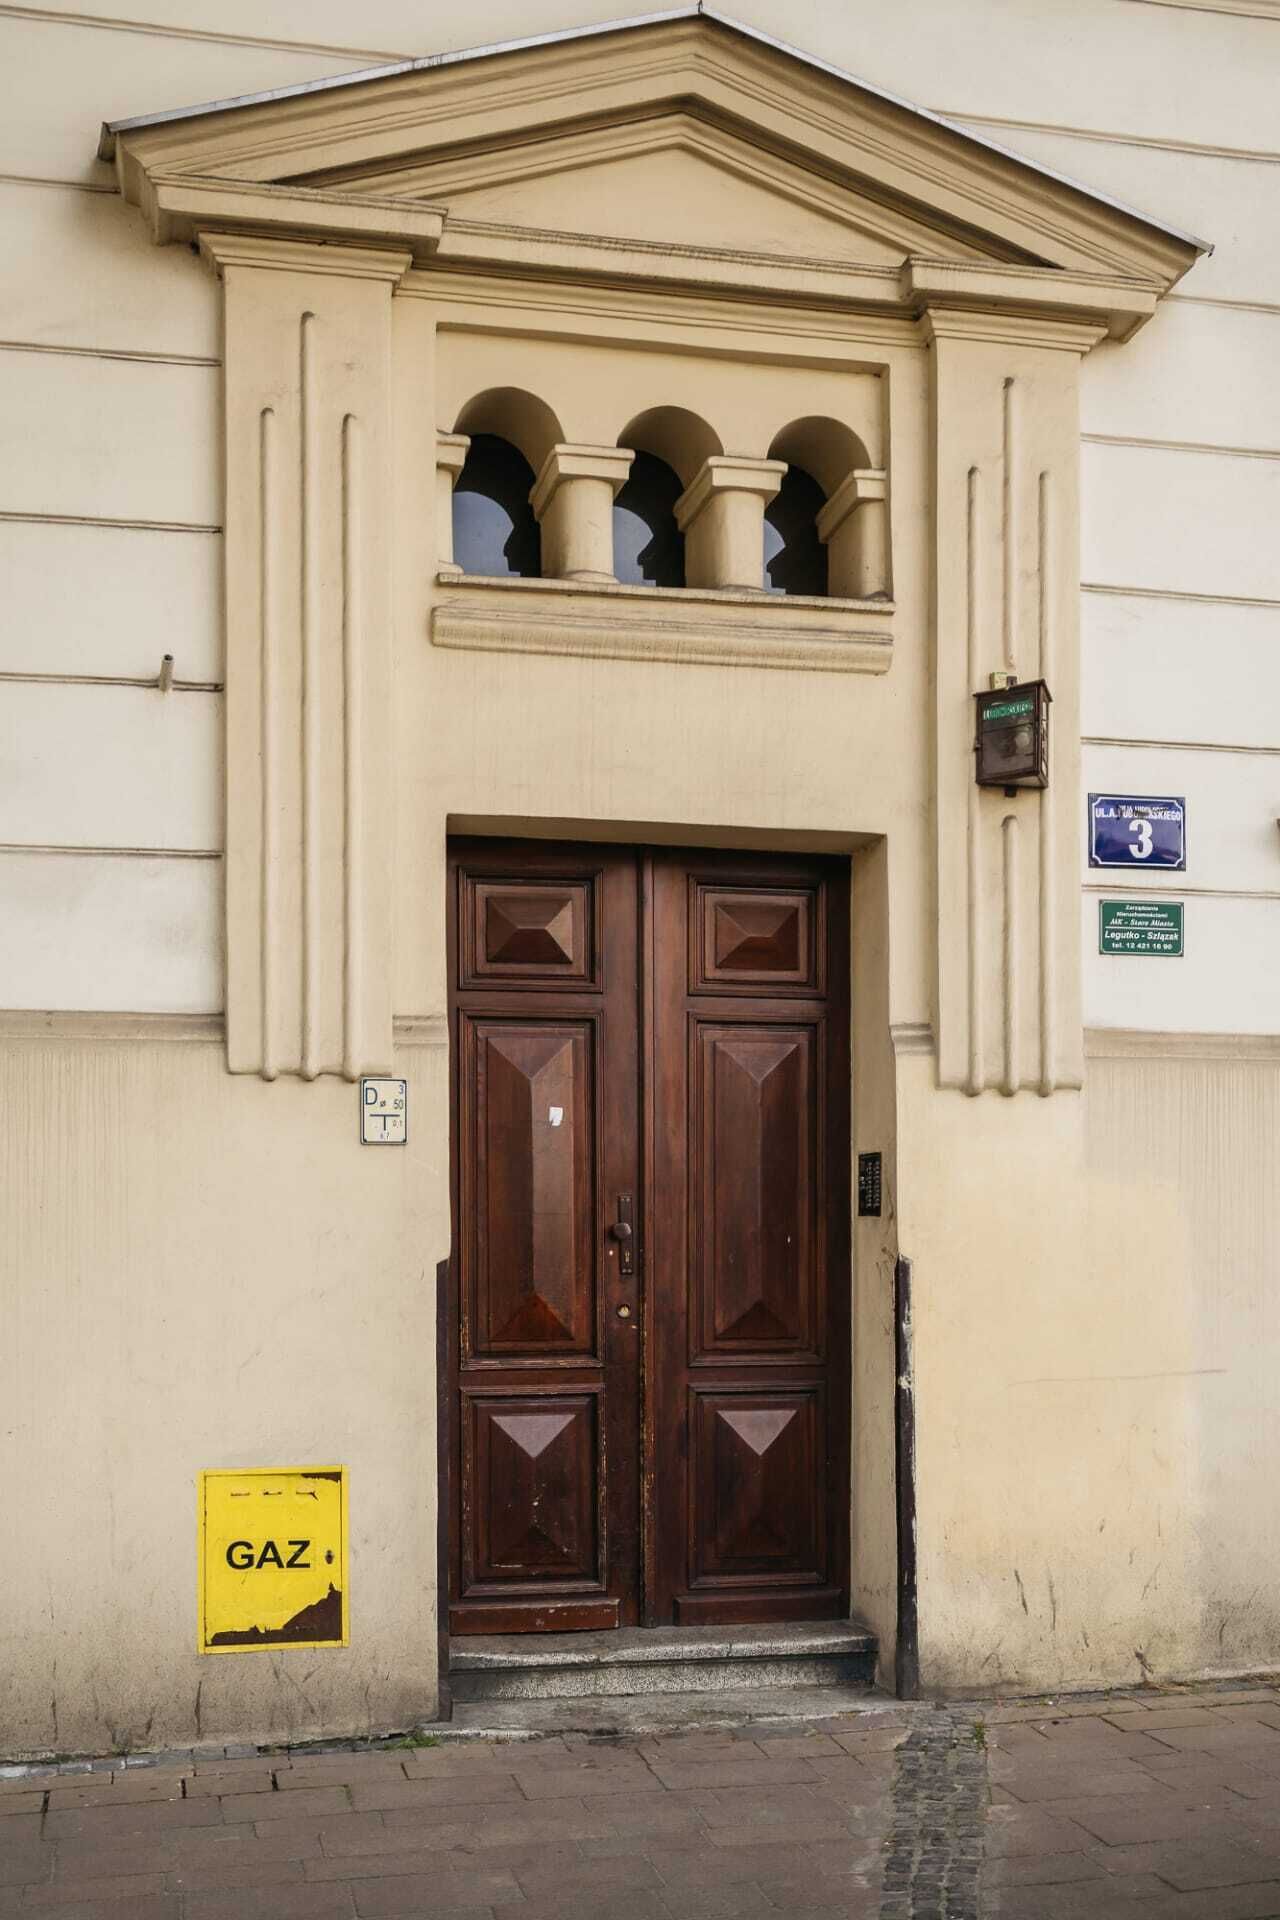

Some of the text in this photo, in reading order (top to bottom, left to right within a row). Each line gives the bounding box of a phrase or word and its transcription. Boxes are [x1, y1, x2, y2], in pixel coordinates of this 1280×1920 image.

[1128, 819, 1153, 859] 3
[1105, 930, 1140, 940] Legutko
[365, 1087, 378, 1105] D
[226, 1540, 311, 1570] GAZ
